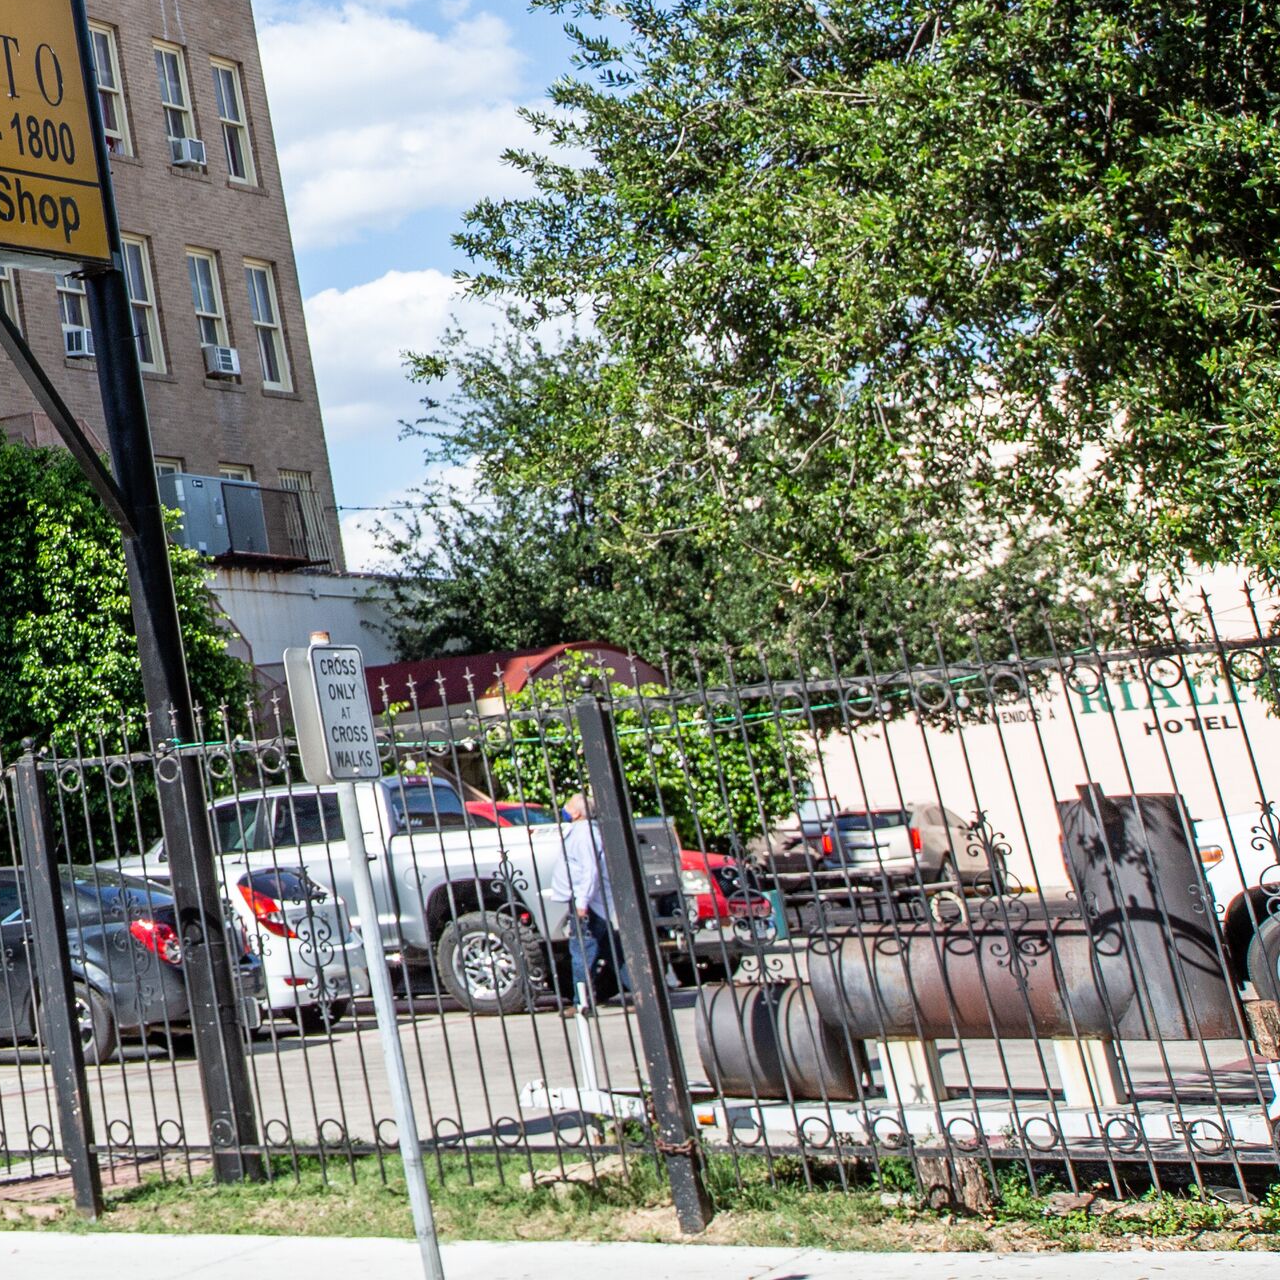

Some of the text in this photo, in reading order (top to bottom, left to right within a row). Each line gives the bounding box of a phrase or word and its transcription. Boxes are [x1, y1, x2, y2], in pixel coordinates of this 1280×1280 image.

[11, 112, 75, 165] 1800
[320, 659, 357, 676] CROSS
[328, 683, 356, 700] ONLY
[341, 707, 352, 719] AT
[1144, 715, 1238, 735] HOTEL
[331, 726, 369, 743] CROSS
[335, 750, 373, 767] WALKS
